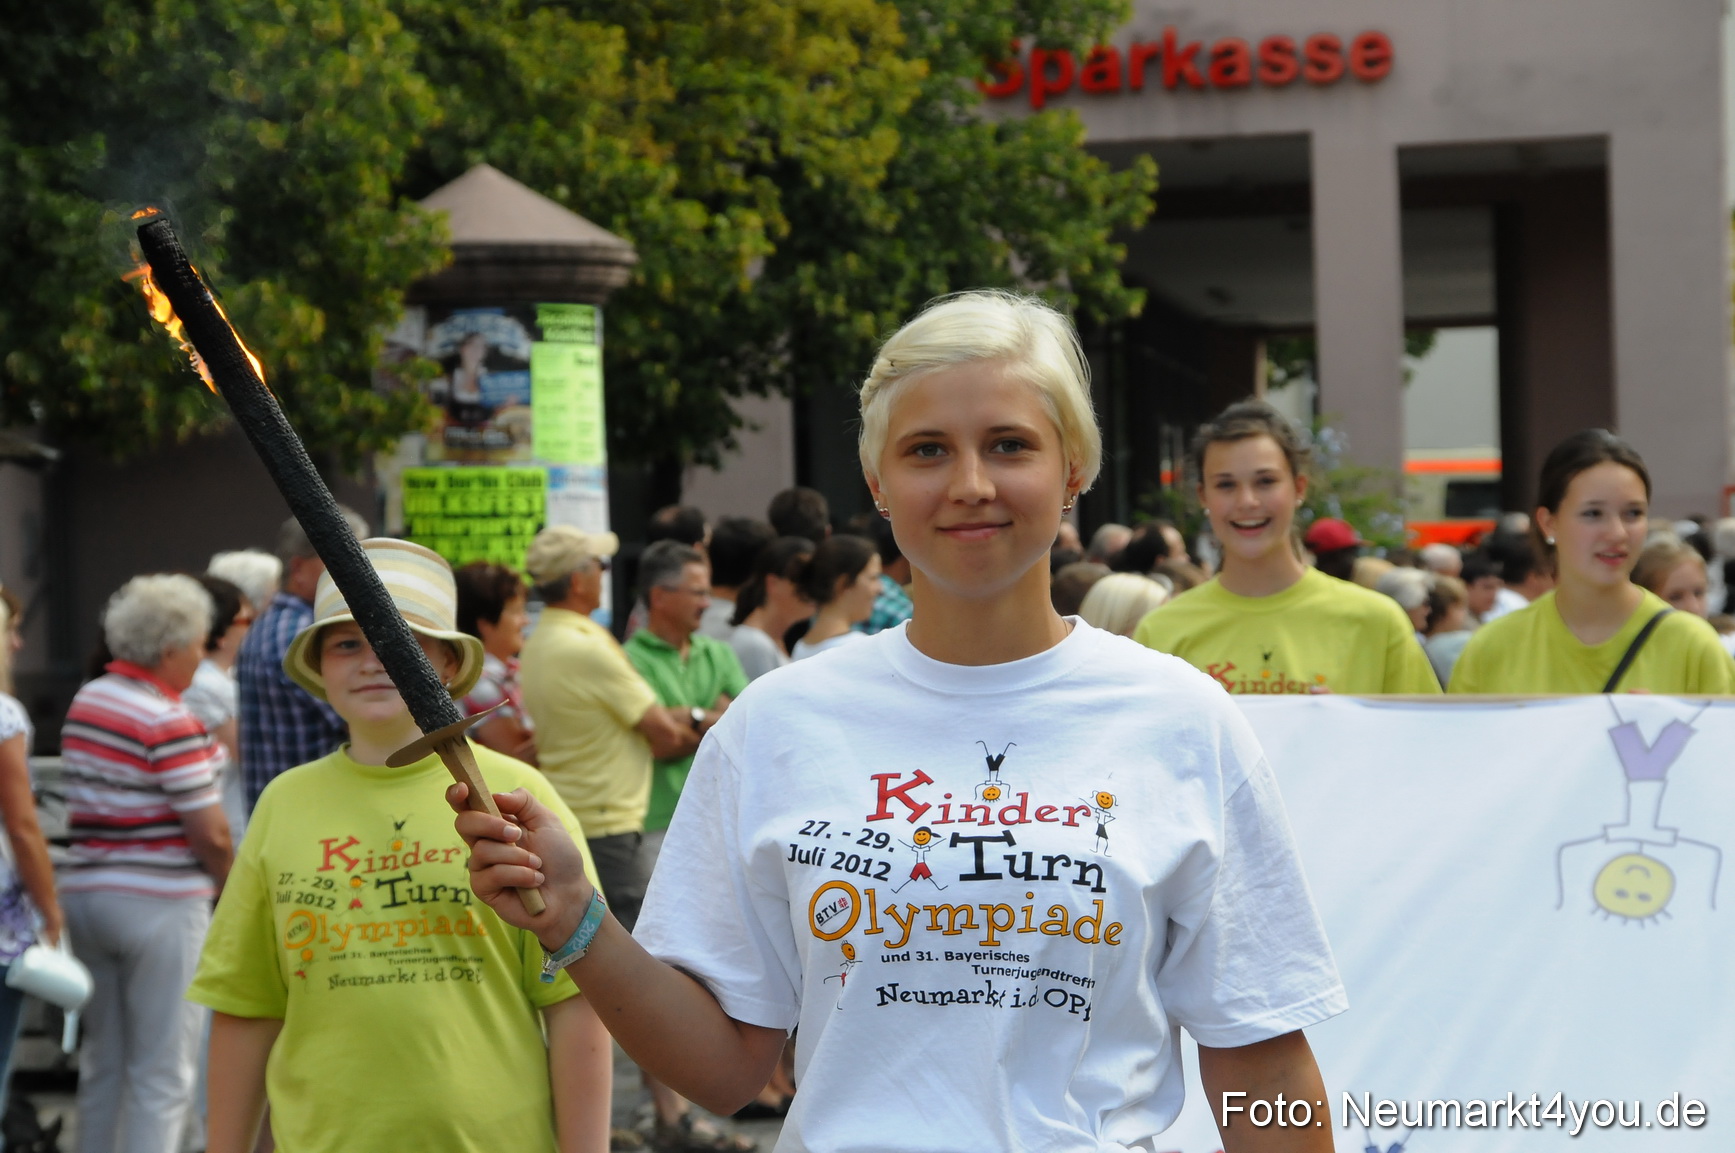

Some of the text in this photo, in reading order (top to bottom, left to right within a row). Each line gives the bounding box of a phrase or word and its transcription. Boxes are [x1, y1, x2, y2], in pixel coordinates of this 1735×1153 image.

[1206, 661, 1312, 694] Kinder
[866, 769, 1092, 828] Kinder
[798, 820, 832, 840] 27.
[856, 828, 895, 853] 29.
[316, 836, 461, 874] Kinder
[787, 844, 892, 882] Juli 2012
[949, 829, 1107, 894] Turn
[278, 872, 294, 886] 27.
[311, 876, 338, 892] 29.
[374, 871, 472, 909] Turn
[295, 891, 336, 911] 2012
[808, 879, 1124, 950] Olympiade
[815, 901, 838, 925] BTV
[880, 950, 1030, 963] und 31. Bayerisches
[328, 967, 417, 990] Neumarkt
[971, 964, 1095, 989] Turnerjugendtreffn
[876, 979, 1006, 1009] Neumarkt
